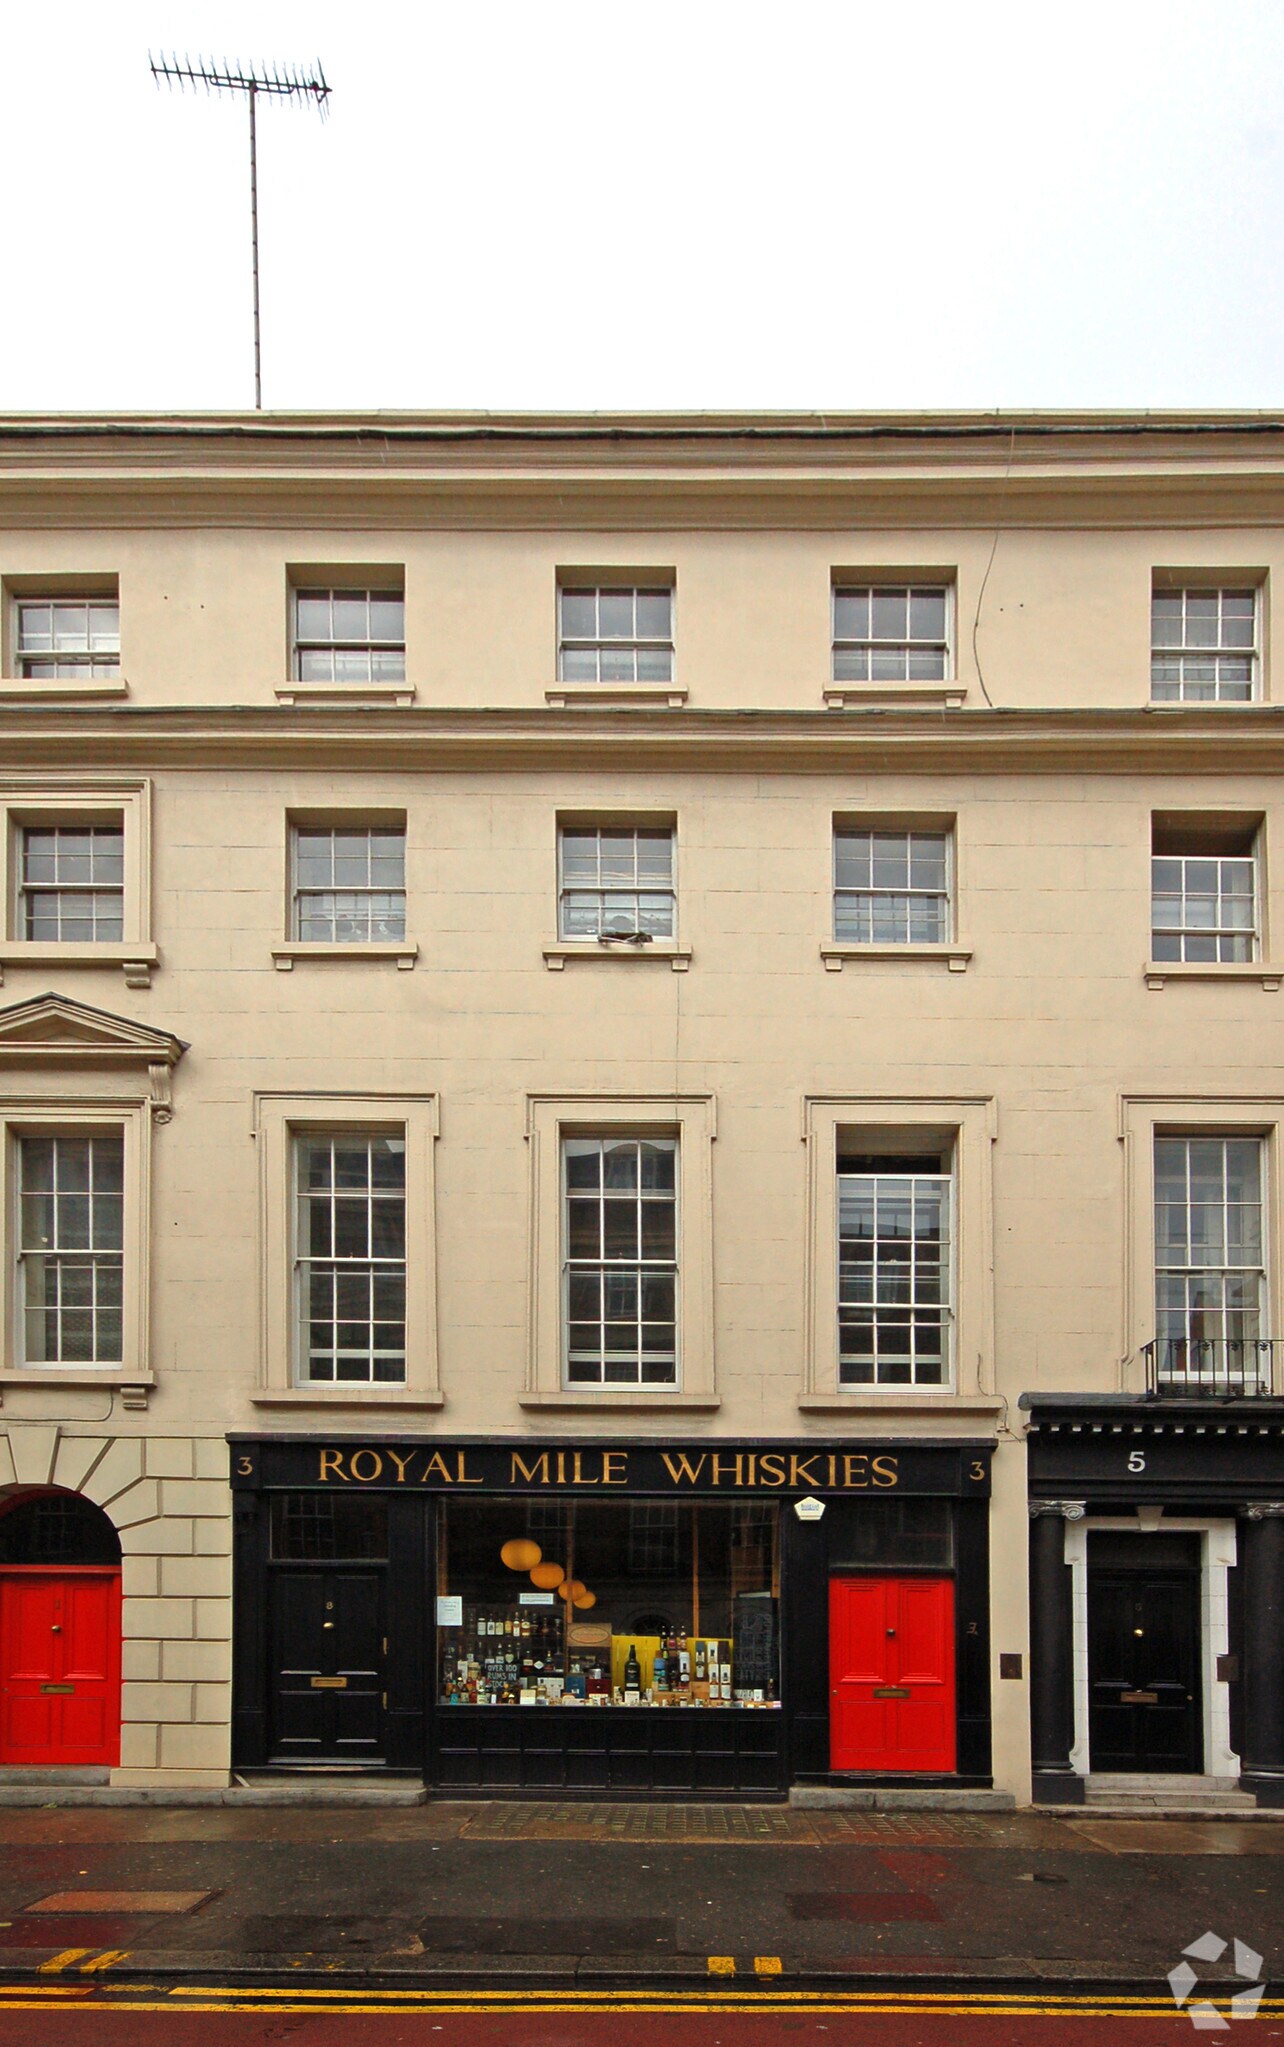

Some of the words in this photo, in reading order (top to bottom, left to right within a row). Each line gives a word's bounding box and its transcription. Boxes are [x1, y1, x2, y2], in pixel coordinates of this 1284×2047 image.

[237, 1457, 253, 1476] 3
[317, 1449, 484, 1483] ROYAL
[510, 1450, 629, 1484] MILE
[661, 1453, 899, 1488] WHISKIES
[969, 1461, 985, 1480] 3
[1128, 1451, 1146, 1473] 5
[487, 1664, 504, 1672] OVER
[505, 1664, 517, 1672] 100
[487, 1672, 507, 1680] RUMS
[508, 1673, 517, 1681] IN
